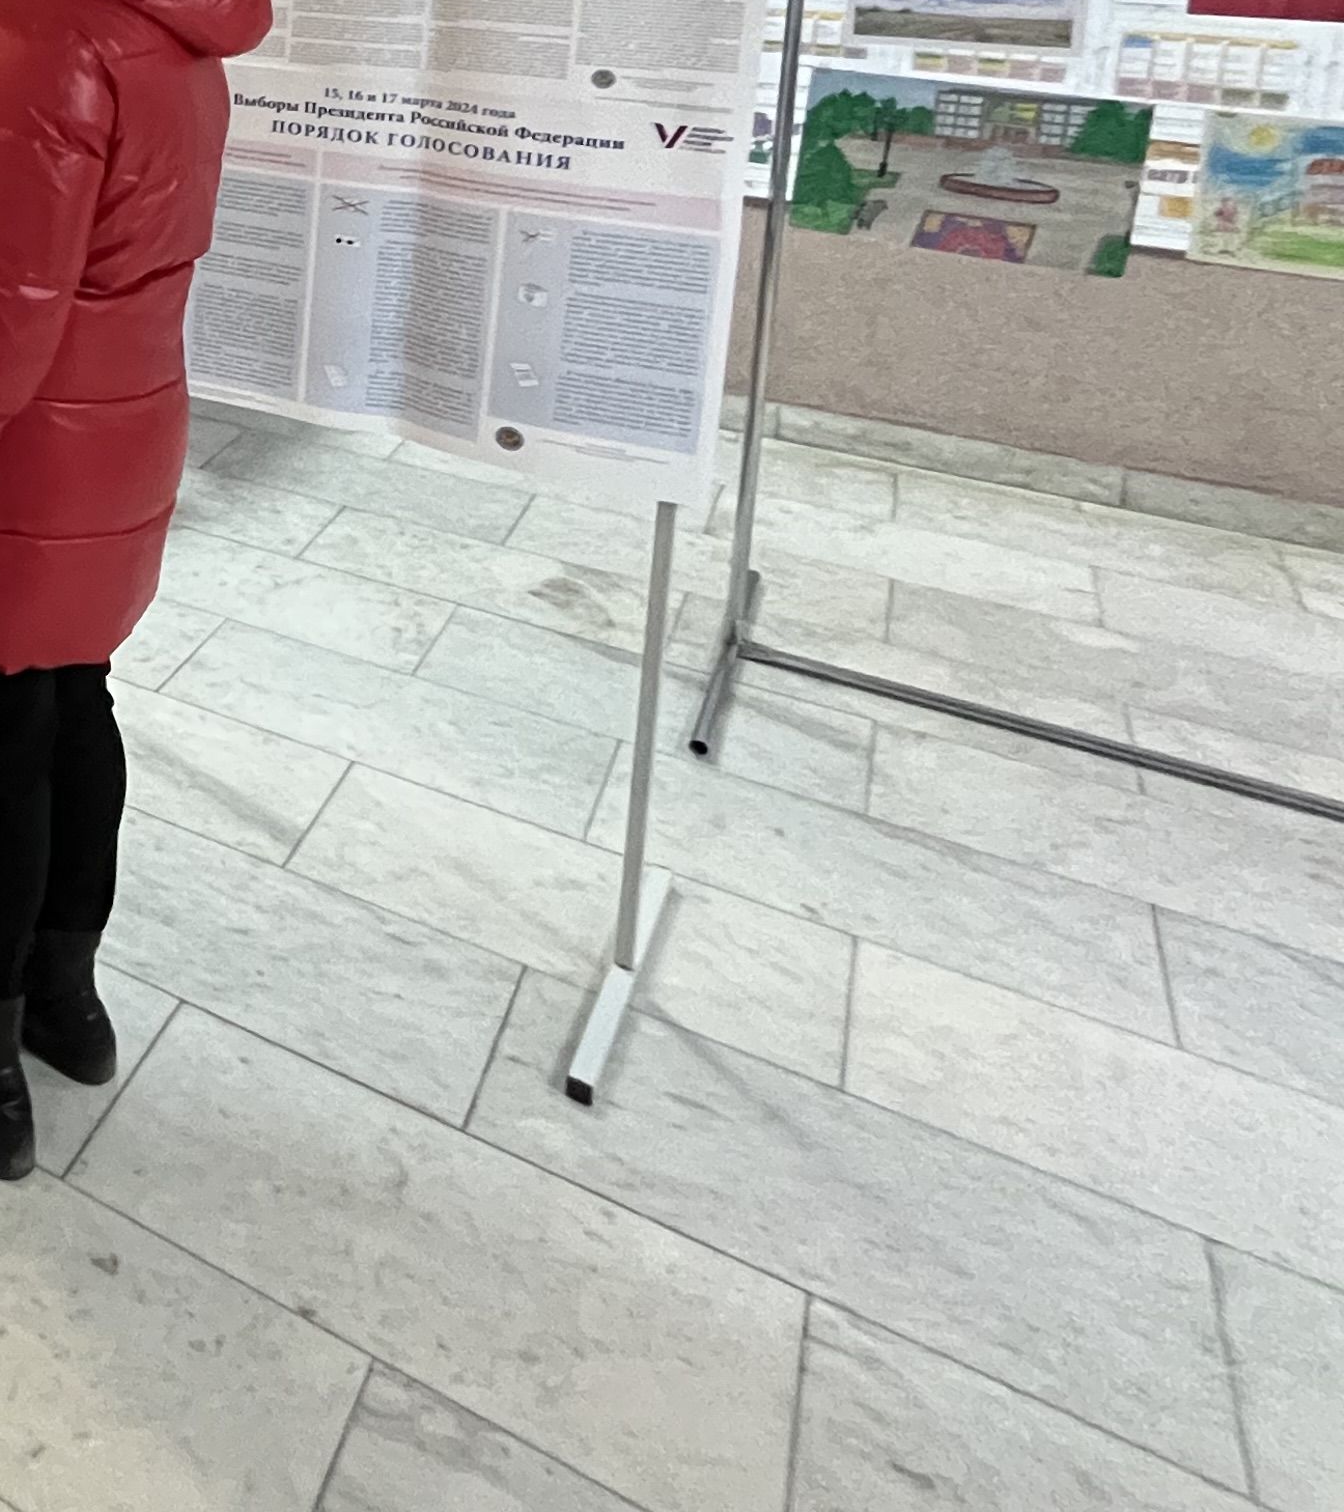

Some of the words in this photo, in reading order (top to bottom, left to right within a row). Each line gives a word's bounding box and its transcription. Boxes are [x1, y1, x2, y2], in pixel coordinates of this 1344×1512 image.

[233, 93, 299, 113] Выборы
[304, 101, 404, 123] Президента
[410, 111, 510, 137] Российской
[514, 126, 625, 150] Федерации
[324, 88, 342, 101] 15,
[348, 89, 364, 102] 16
[367, 94, 376, 102] и
[382, 92, 398, 104] 17
[401, 95, 443, 110] марта
[446, 99, 479, 114] 2024
[481, 106, 516, 119] года
[271, 120, 381, 145] ПОРЯДОК
[387, 132, 572, 170] ГОЛОСОВАНИЯ
